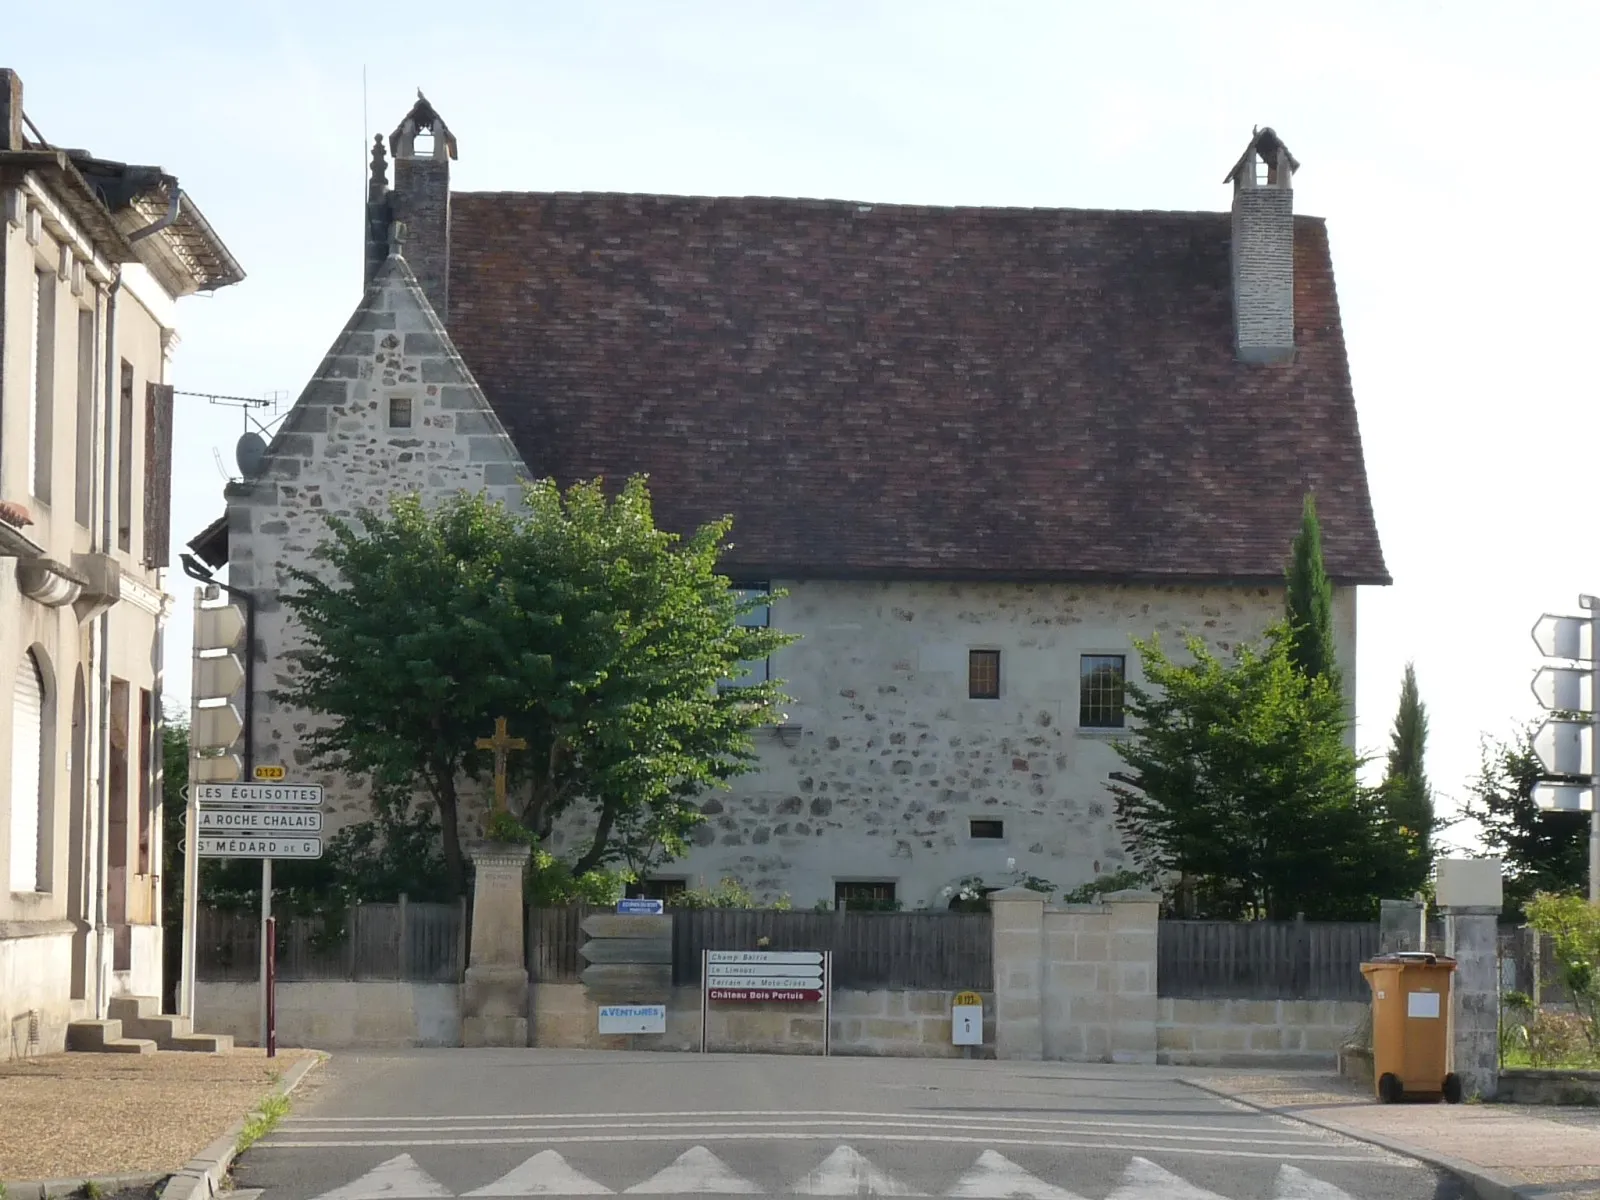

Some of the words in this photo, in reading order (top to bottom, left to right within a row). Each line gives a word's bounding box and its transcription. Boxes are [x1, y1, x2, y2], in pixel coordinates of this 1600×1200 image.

[231, 787, 317, 800] ÉGLISOTTES
[198, 815, 211, 825] A
[216, 815, 258, 825] ROCHE
[263, 816, 316, 826] CHALAIS
[216, 840, 276, 852] MÉDARD
[303, 843, 316, 853] G.
[711, 953, 738, 961] Champ
[711, 991, 747, 999] Château
[750, 991, 769, 999] Bois
[772, 991, 804, 1000] Pertuis
[600, 1007, 659, 1017] AVENTURES
